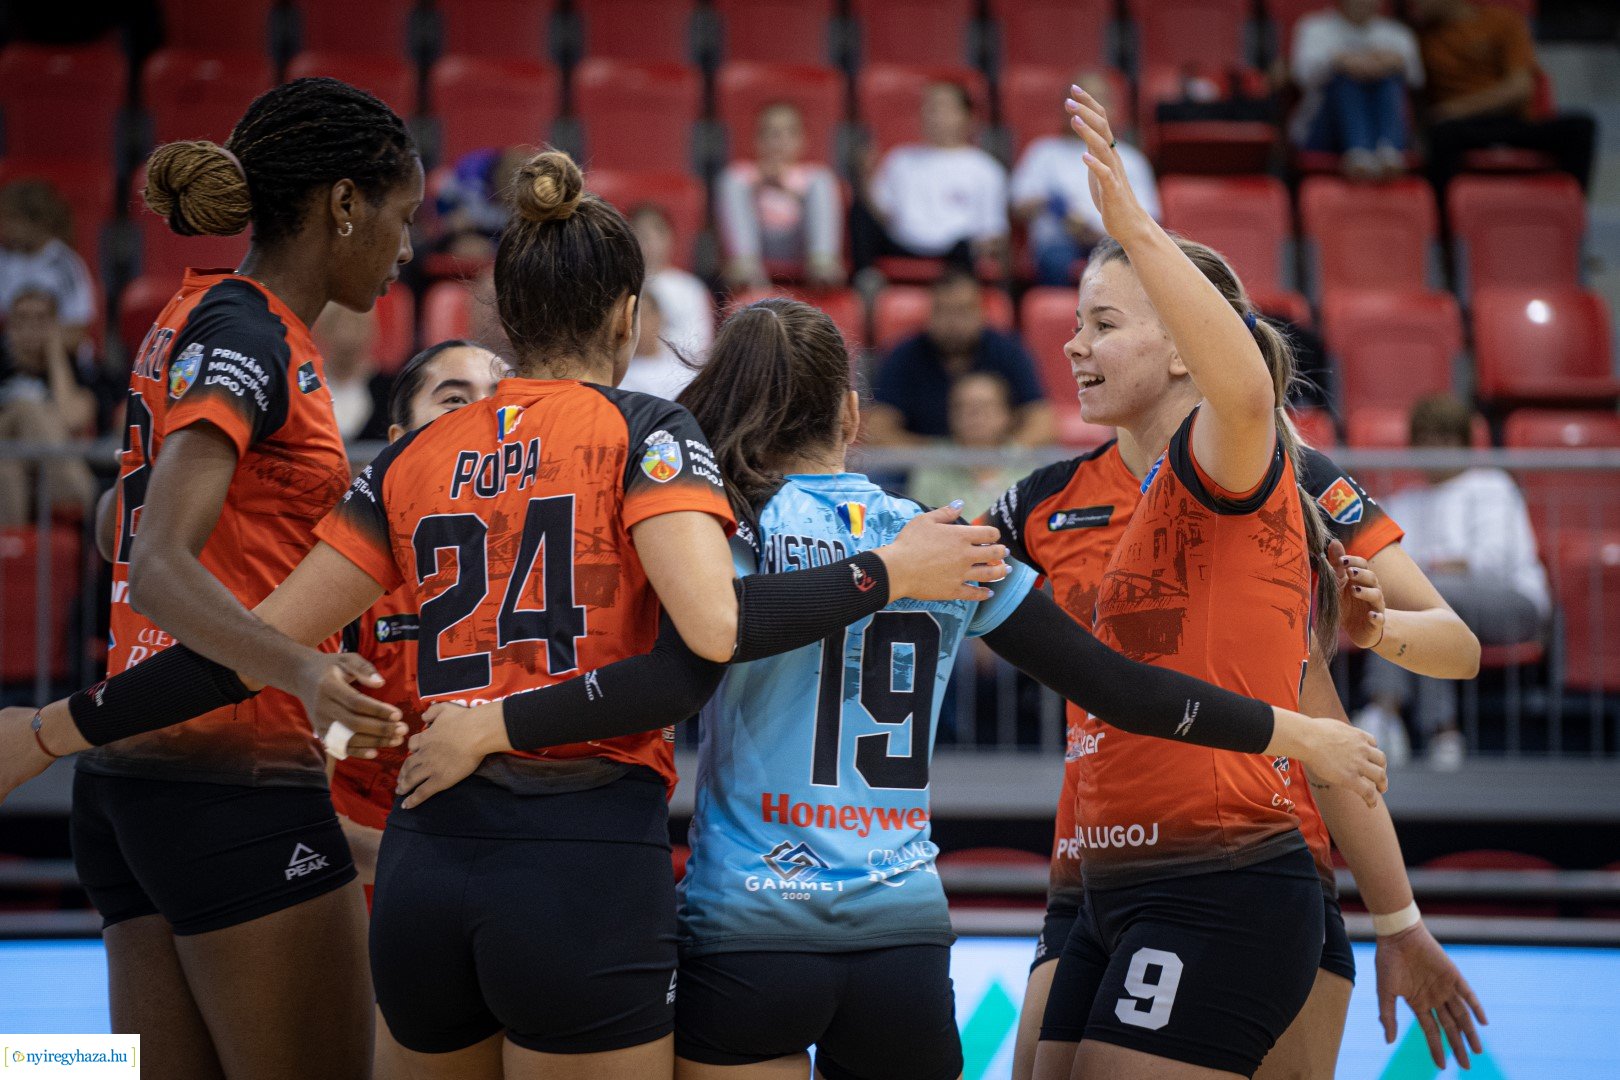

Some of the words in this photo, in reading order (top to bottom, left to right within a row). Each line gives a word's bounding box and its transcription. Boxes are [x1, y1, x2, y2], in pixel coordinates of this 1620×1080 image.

[449, 436, 541, 499] POPA
[412, 493, 587, 700] 24
[809, 611, 932, 791] 19
[1087, 822, 1159, 849] LUGOJ
[284, 855, 330, 881] PEAK
[781, 892, 811, 901] 2000
[1114, 946, 1185, 1031] 9
